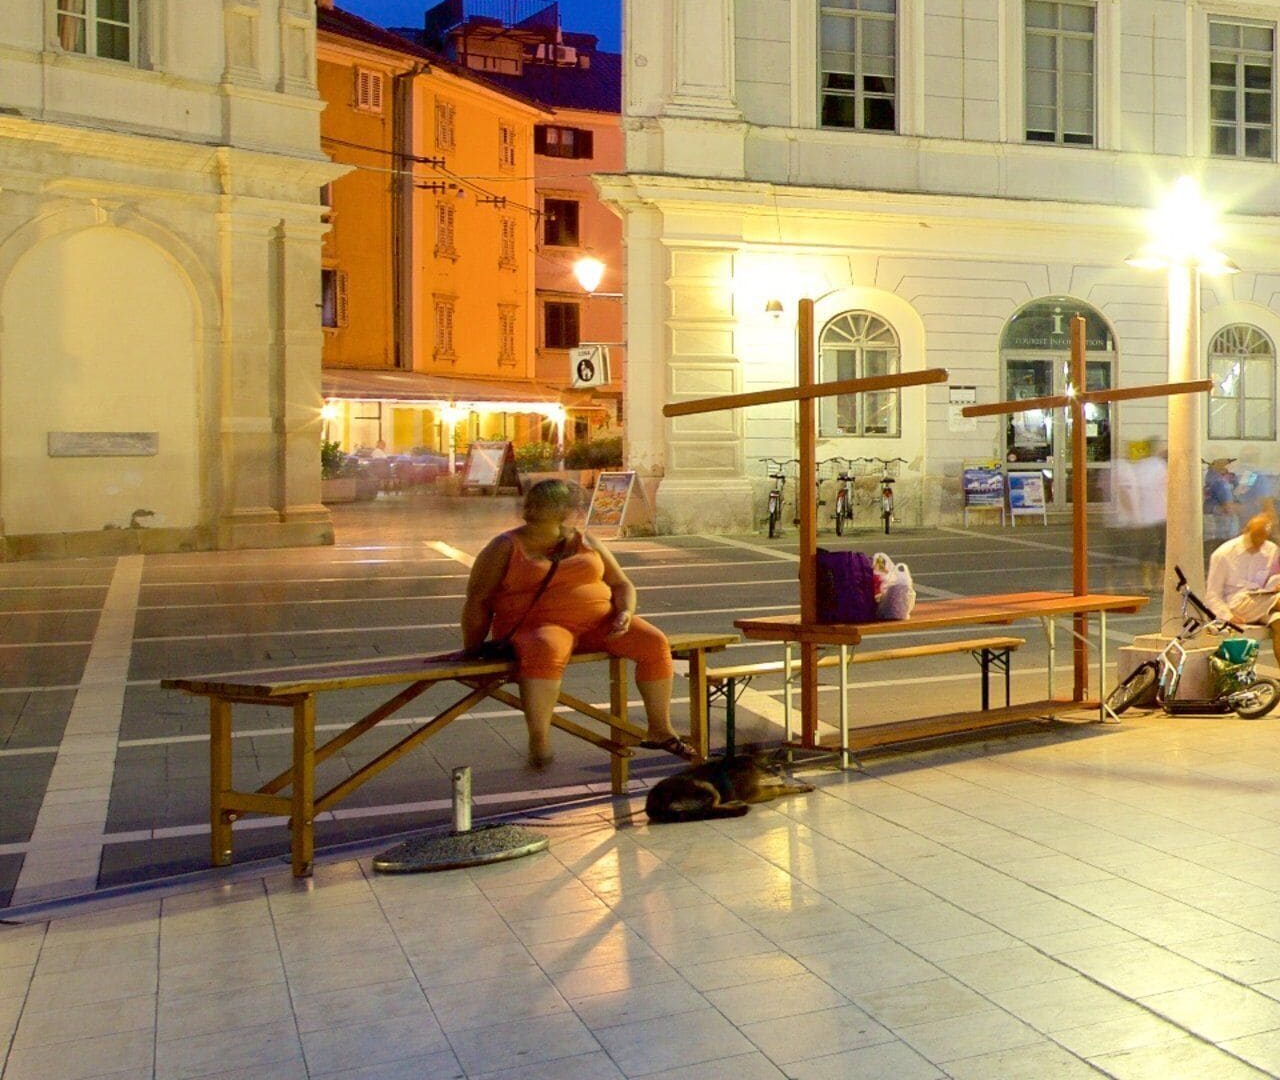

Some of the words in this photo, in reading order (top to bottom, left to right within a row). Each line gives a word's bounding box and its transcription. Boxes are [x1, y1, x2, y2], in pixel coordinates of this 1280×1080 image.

[1051, 307, 1064, 334] i
[1015, 337, 1047, 345] TOURIST
[1050, 338, 1105, 347] INFORTION
